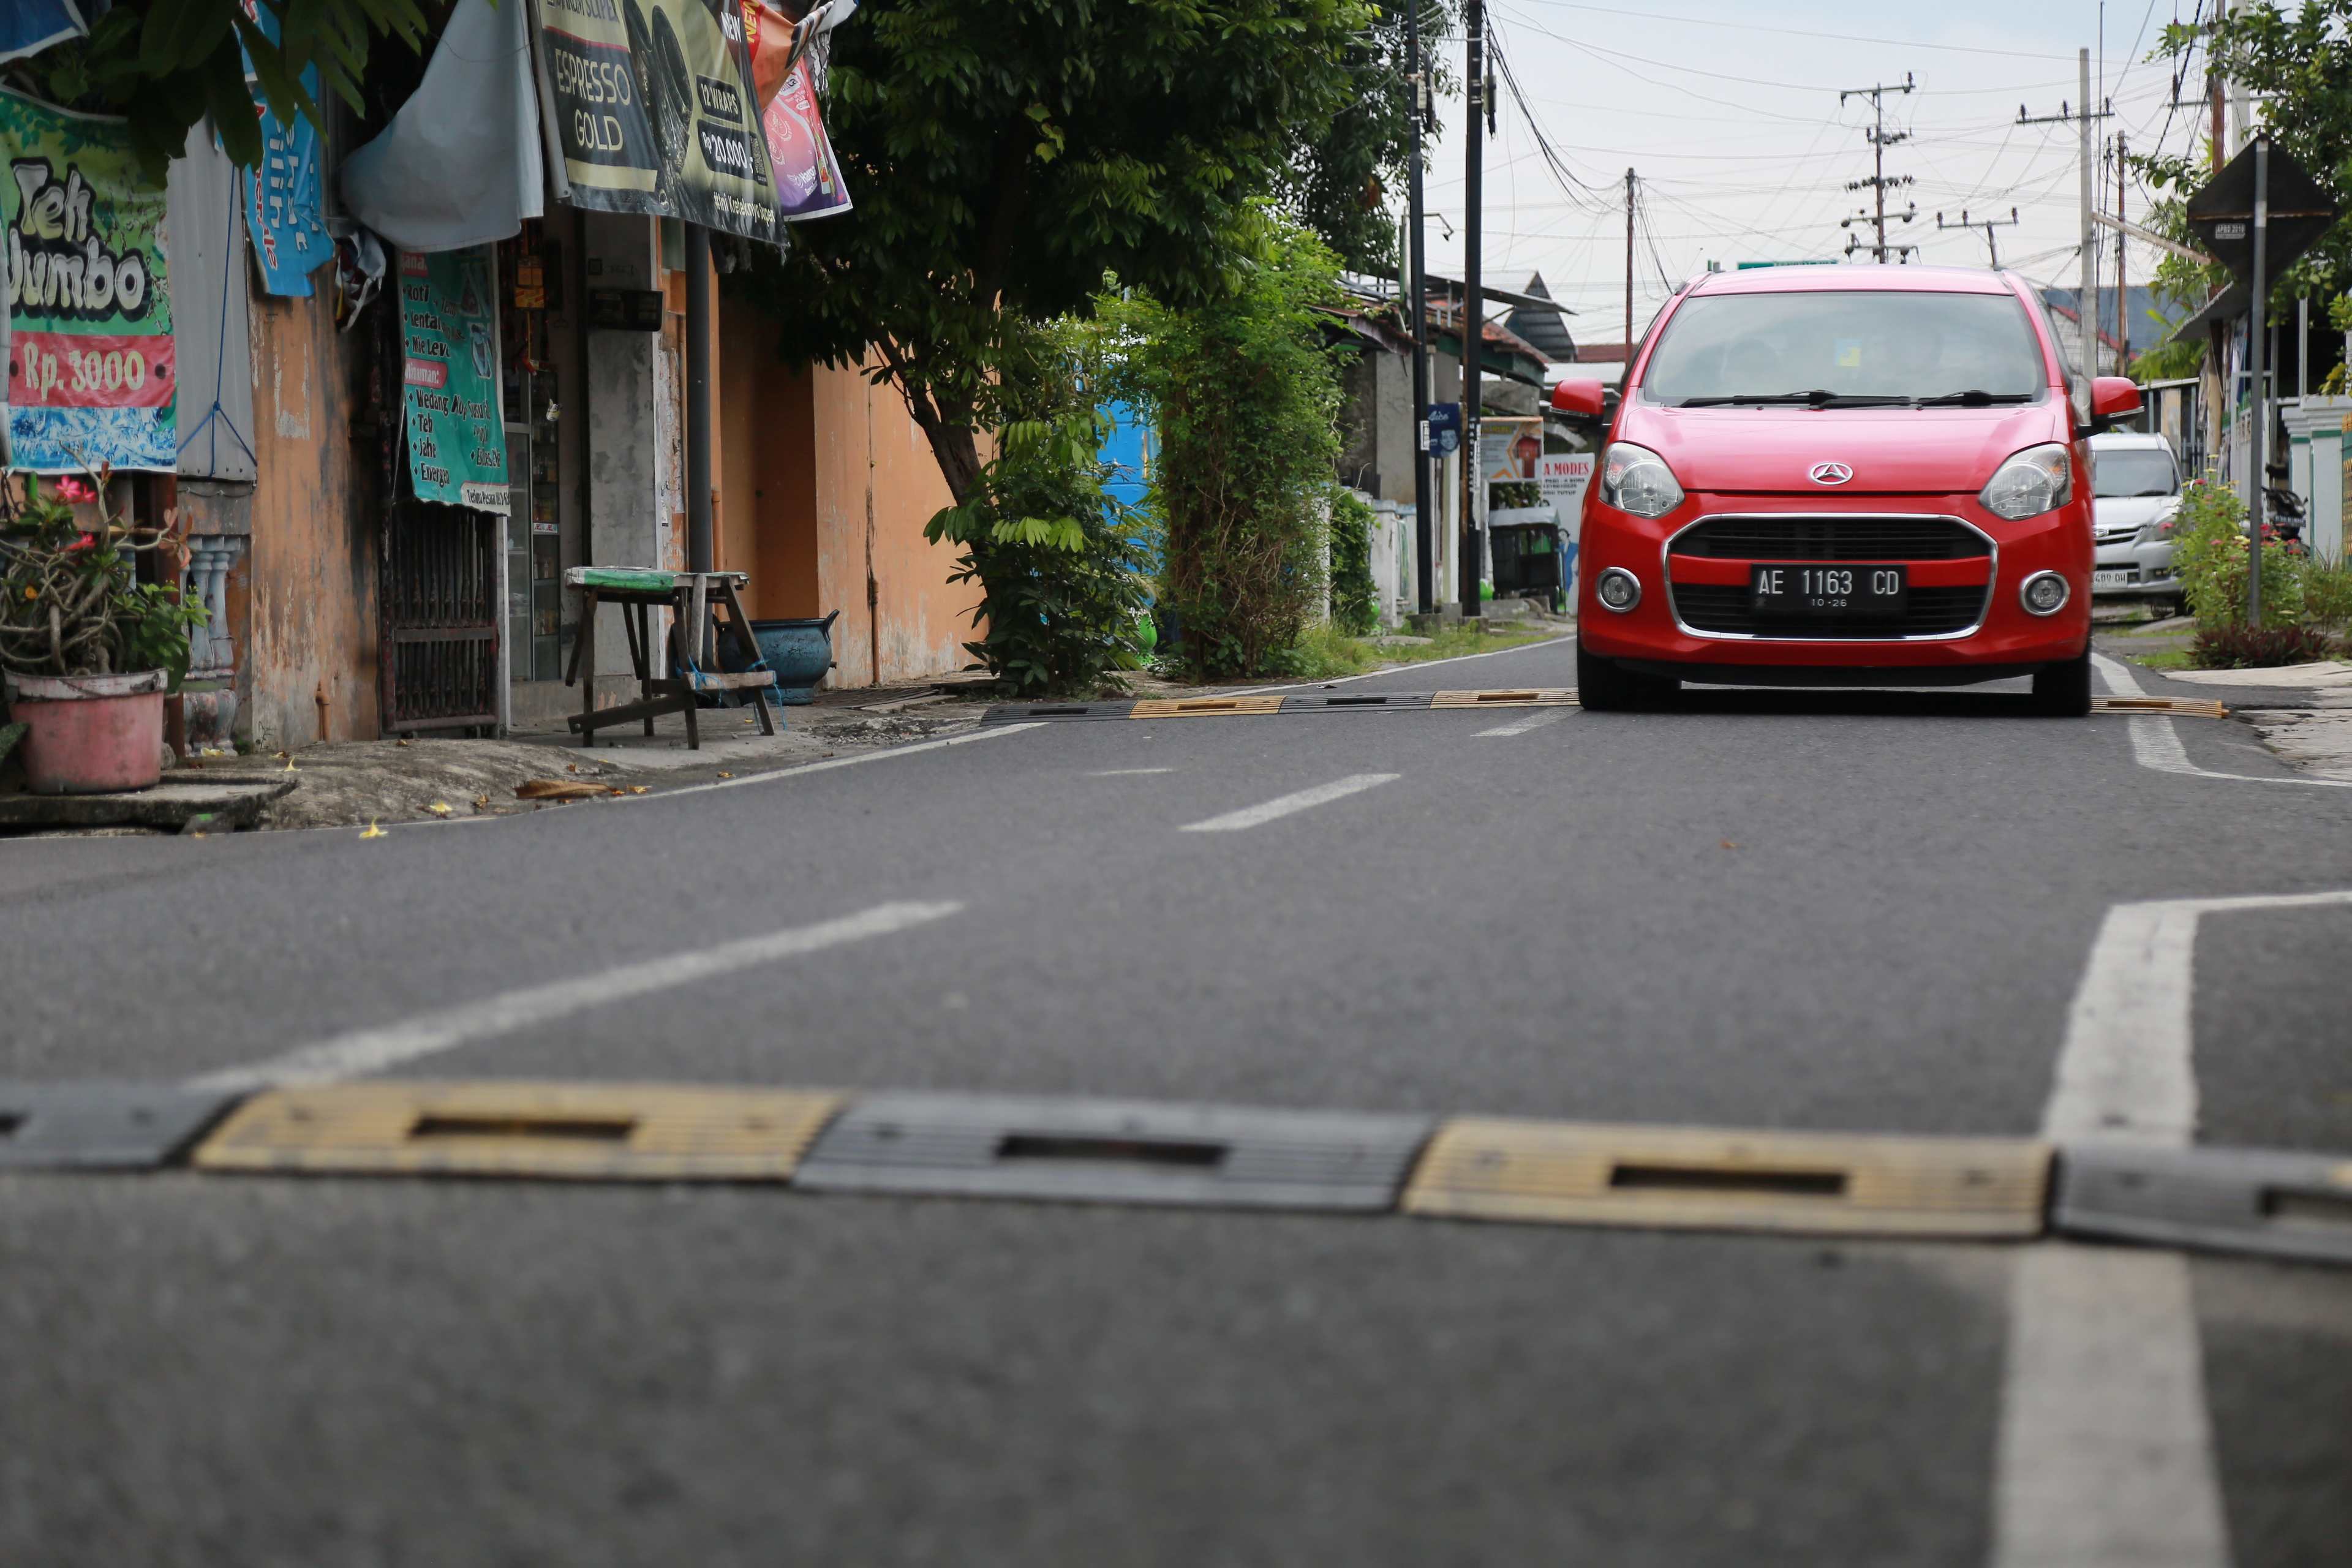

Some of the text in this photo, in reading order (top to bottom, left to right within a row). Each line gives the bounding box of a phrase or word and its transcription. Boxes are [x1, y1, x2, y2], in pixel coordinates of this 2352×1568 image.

[720, 11, 742, 43] NEW
[742, 0, 761, 43] NEW
[555, 48, 631, 106] ESPRESSO
[700, 83, 739, 116] 12 WRAPS
[575, 108, 624, 151] GOLD
[702, 131, 712, 154] Rp
[13, 163, 91, 243] Teh
[9, 227, 146, 311] Jumbo
[23, 341, 145, 402] Rp. 3000
[416, 389, 449, 417] Wedang
[418, 412, 433, 433] Teh
[419, 438, 437, 458] Jahe
[420, 461, 450, 488] Energen
[1554, 461, 1589, 476] MODES
[1758, 570, 1899, 595] AE 1163 CD
